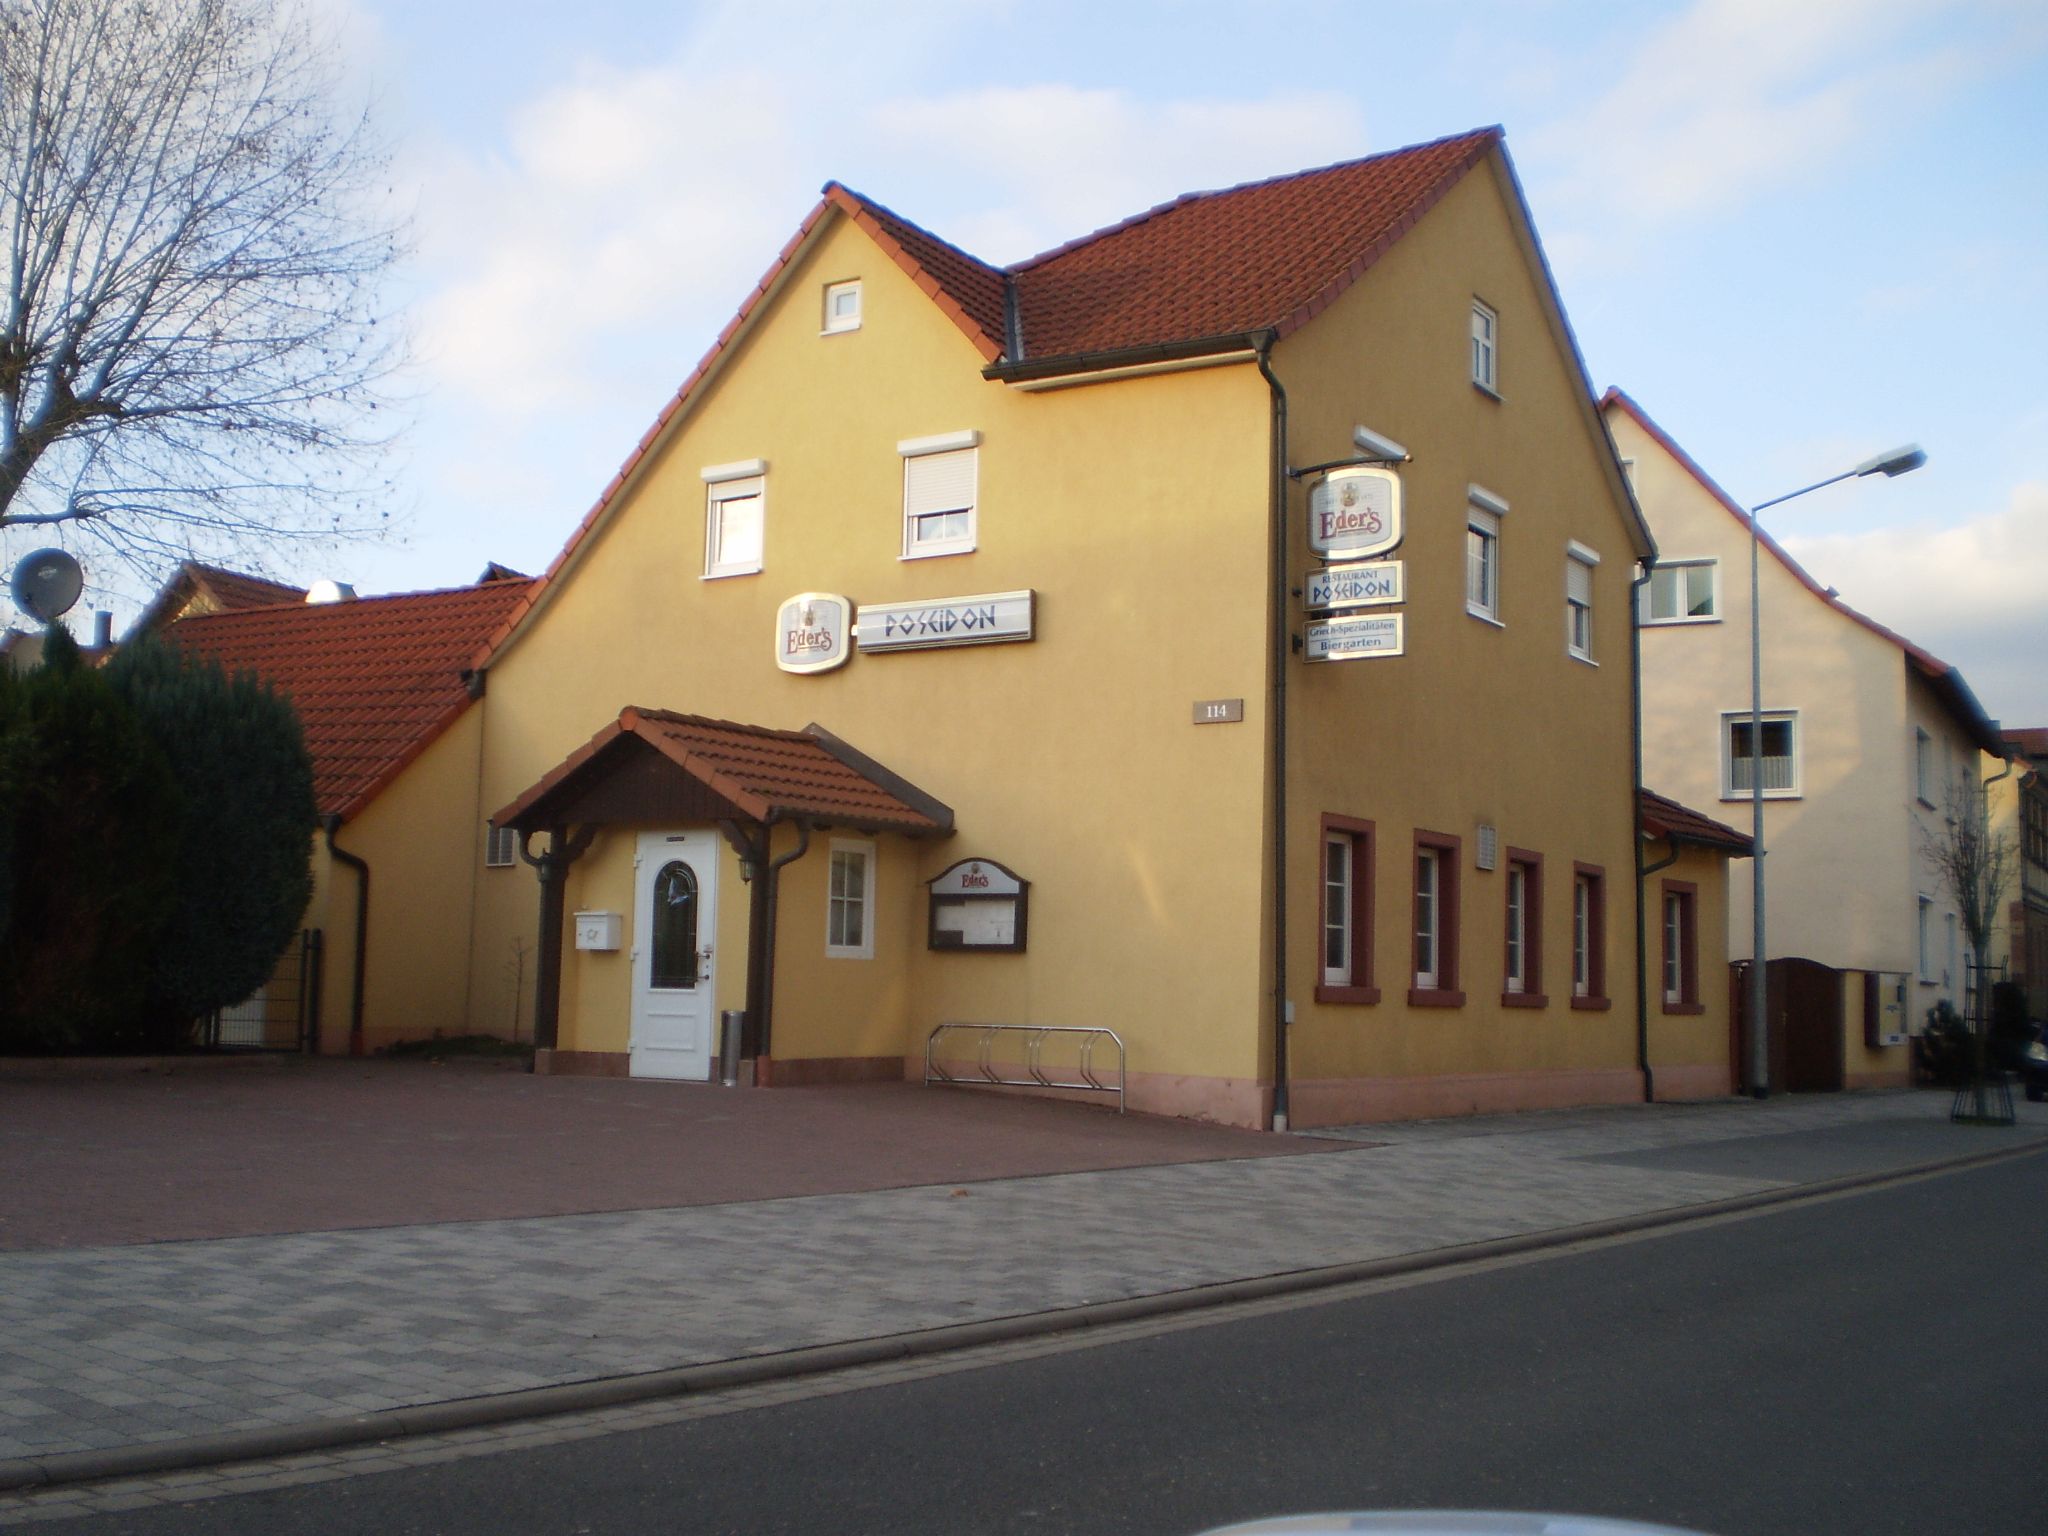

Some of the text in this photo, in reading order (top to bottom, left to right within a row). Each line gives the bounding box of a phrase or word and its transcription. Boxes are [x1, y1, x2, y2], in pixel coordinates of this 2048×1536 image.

[1319, 507, 1383, 540] Eder's
[1313, 579, 1390, 602] POSEIDON
[885, 605, 996, 637] POSEIDON
[786, 627, 833, 655] Eder's
[1320, 638, 1381, 651] Biergarten
[1207, 704, 1226, 718] 114
